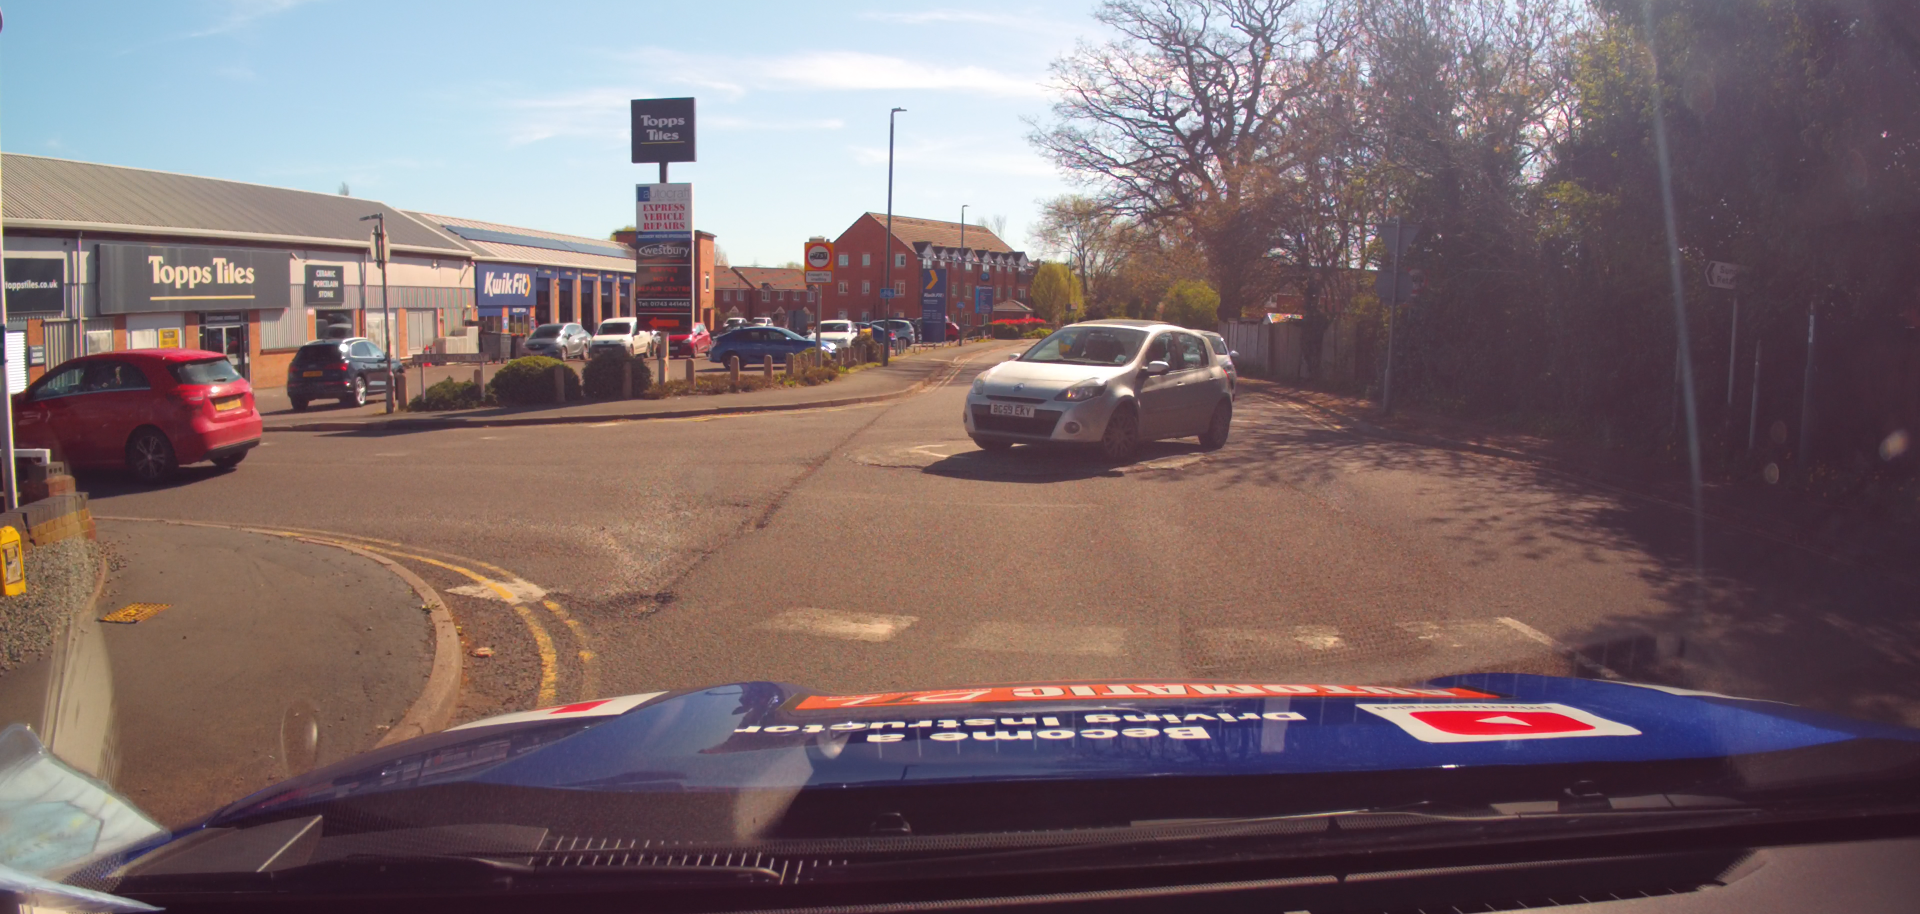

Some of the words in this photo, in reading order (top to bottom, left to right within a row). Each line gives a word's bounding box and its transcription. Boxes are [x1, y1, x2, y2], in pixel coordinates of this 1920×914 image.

[640, 114, 686, 128] Topps
[646, 129, 680, 141] Tiles
[643, 188, 690, 199] autocraft
[643, 203, 686, 212] EXPRESS
[644, 212, 685, 221] VEHICLE
[643, 221, 686, 230] REPAIRS
[643, 245, 690, 257] westbury
[148, 255, 212, 289] Topps
[212, 257, 255, 284] Tiles
[316, 269, 336, 278] CERAMIC
[4, 279, 58, 291] toppstiles.co.uk
[313, 280, 339, 288] PORCELAIN
[318, 290, 334, 298] STONE
[1011, 684, 1457, 697] AUTOMATIC
[1083, 711, 1307, 723] Driving
[733, 715, 1061, 734] Instructor
[866, 733, 906, 743] a
[929, 726, 1212, 741] Become
